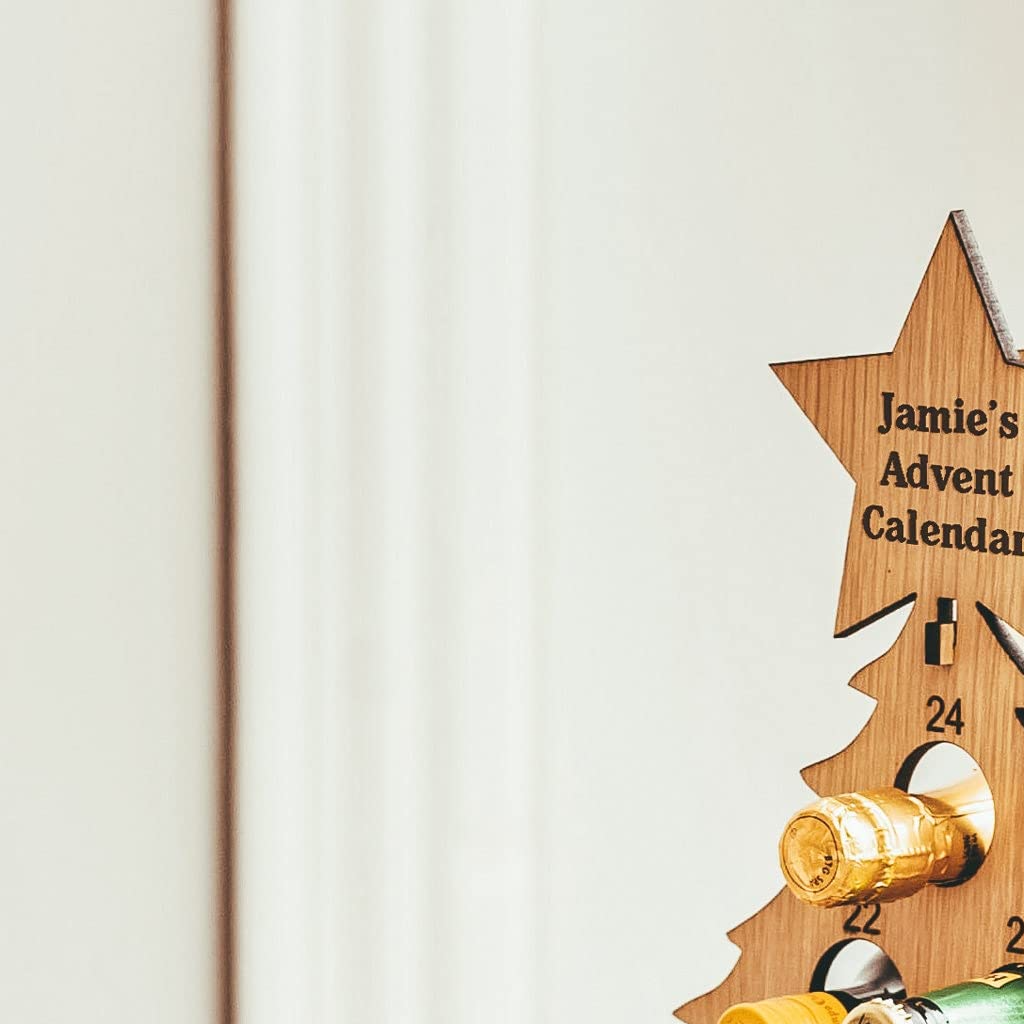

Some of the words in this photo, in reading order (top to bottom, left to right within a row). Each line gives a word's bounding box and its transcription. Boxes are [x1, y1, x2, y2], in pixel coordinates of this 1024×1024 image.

[877, 391, 1019, 440] Jamie's
[880, 450, 1014, 498] Advent
[925, 695, 965, 735] 24
[842, 903, 882, 936] 22
